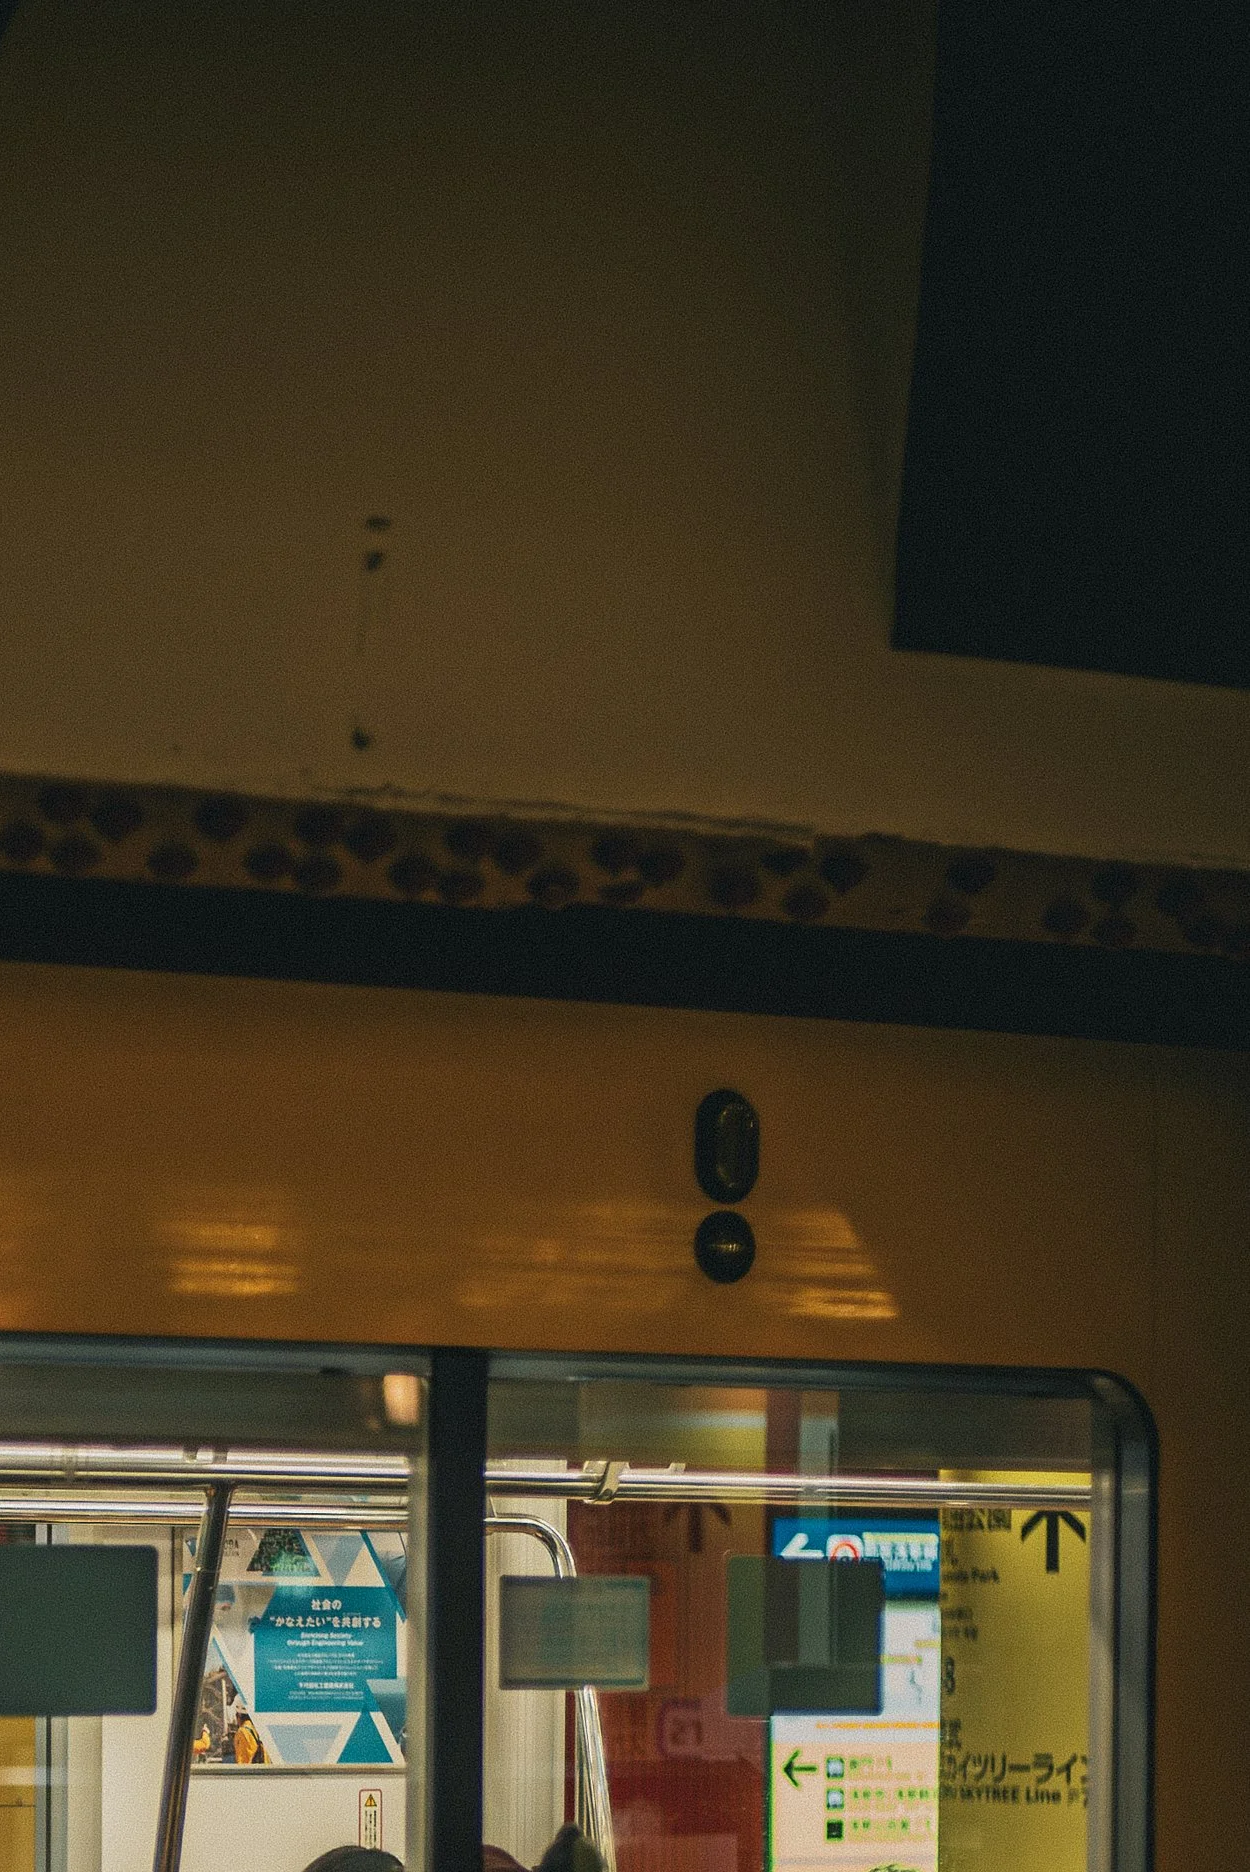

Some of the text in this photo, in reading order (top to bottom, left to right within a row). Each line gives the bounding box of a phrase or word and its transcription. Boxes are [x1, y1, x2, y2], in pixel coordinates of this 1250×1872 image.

[311, 1599, 342, 1611] 社会の
[1025, 1785, 1062, 1806] Line
